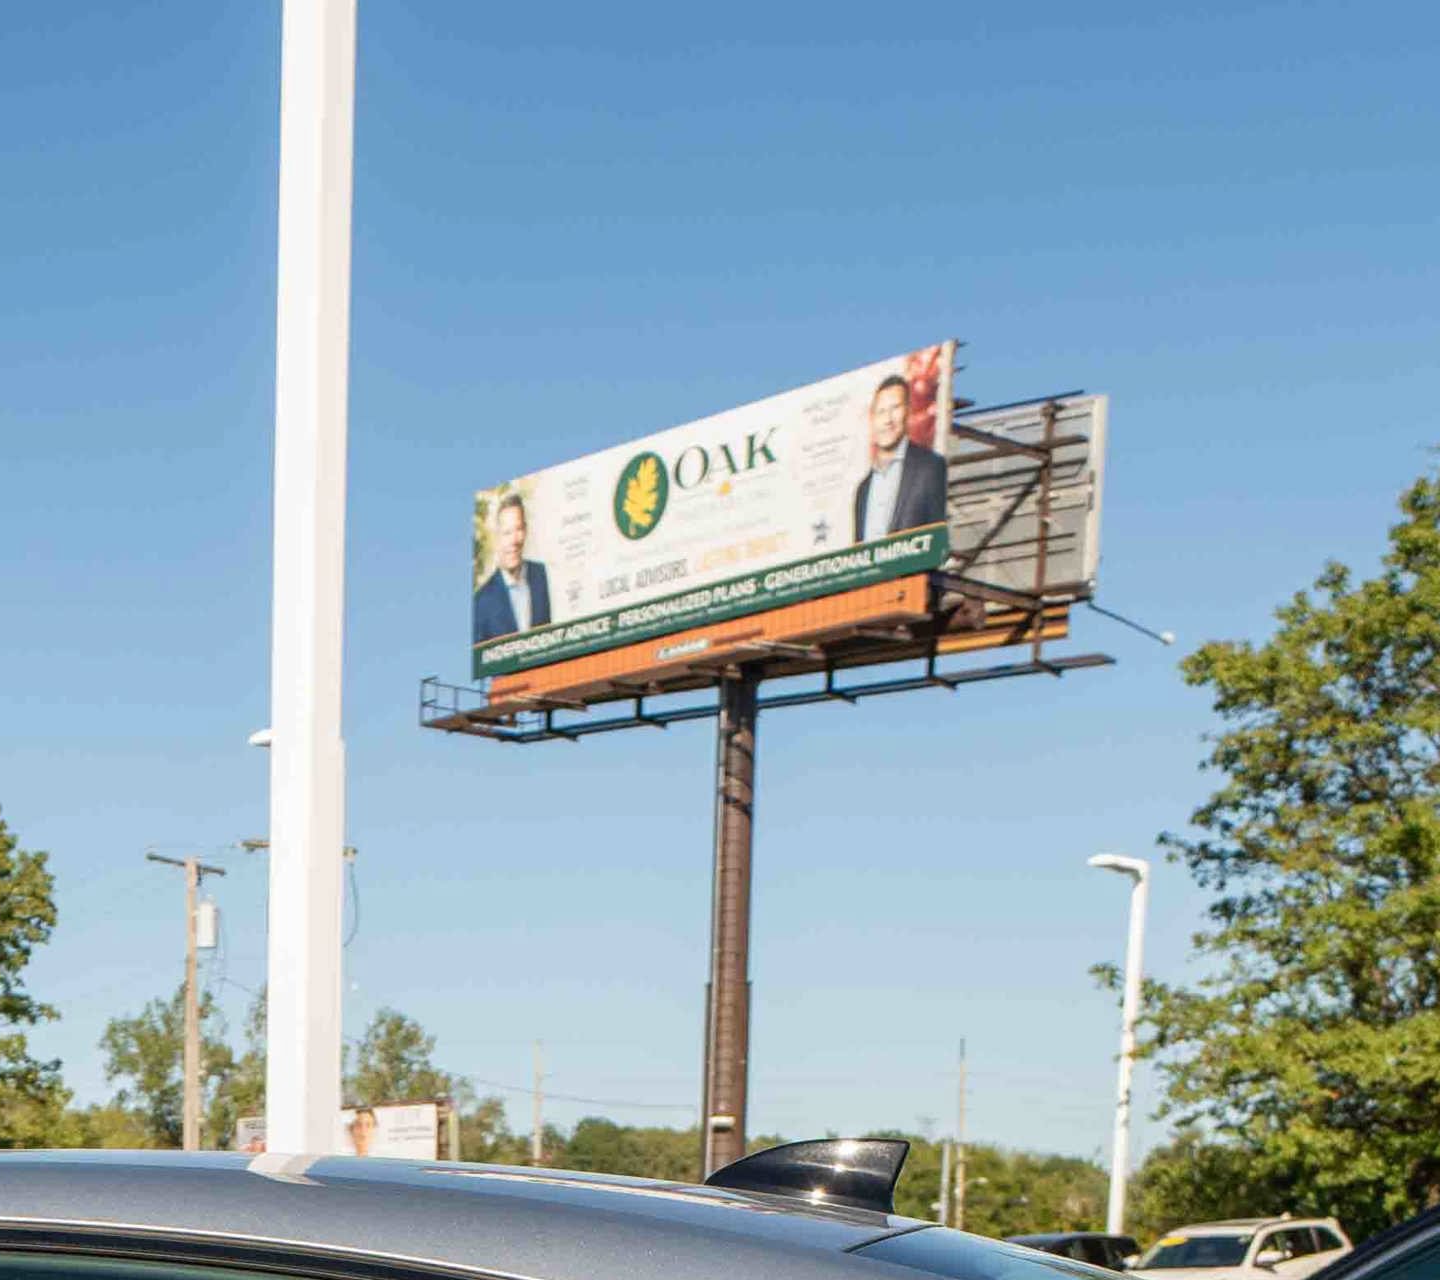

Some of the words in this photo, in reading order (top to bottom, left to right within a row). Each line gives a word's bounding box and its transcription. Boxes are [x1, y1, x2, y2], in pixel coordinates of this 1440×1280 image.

[674, 426, 780, 489] OAK
[563, 615, 611, 641] ADVICE
[618, 589, 712, 628] PERSONALIZED
[712, 577, 757, 602] PLANS
[764, 550, 872, 590] GENERATIONAL
[874, 534, 933, 564] IMPACT
